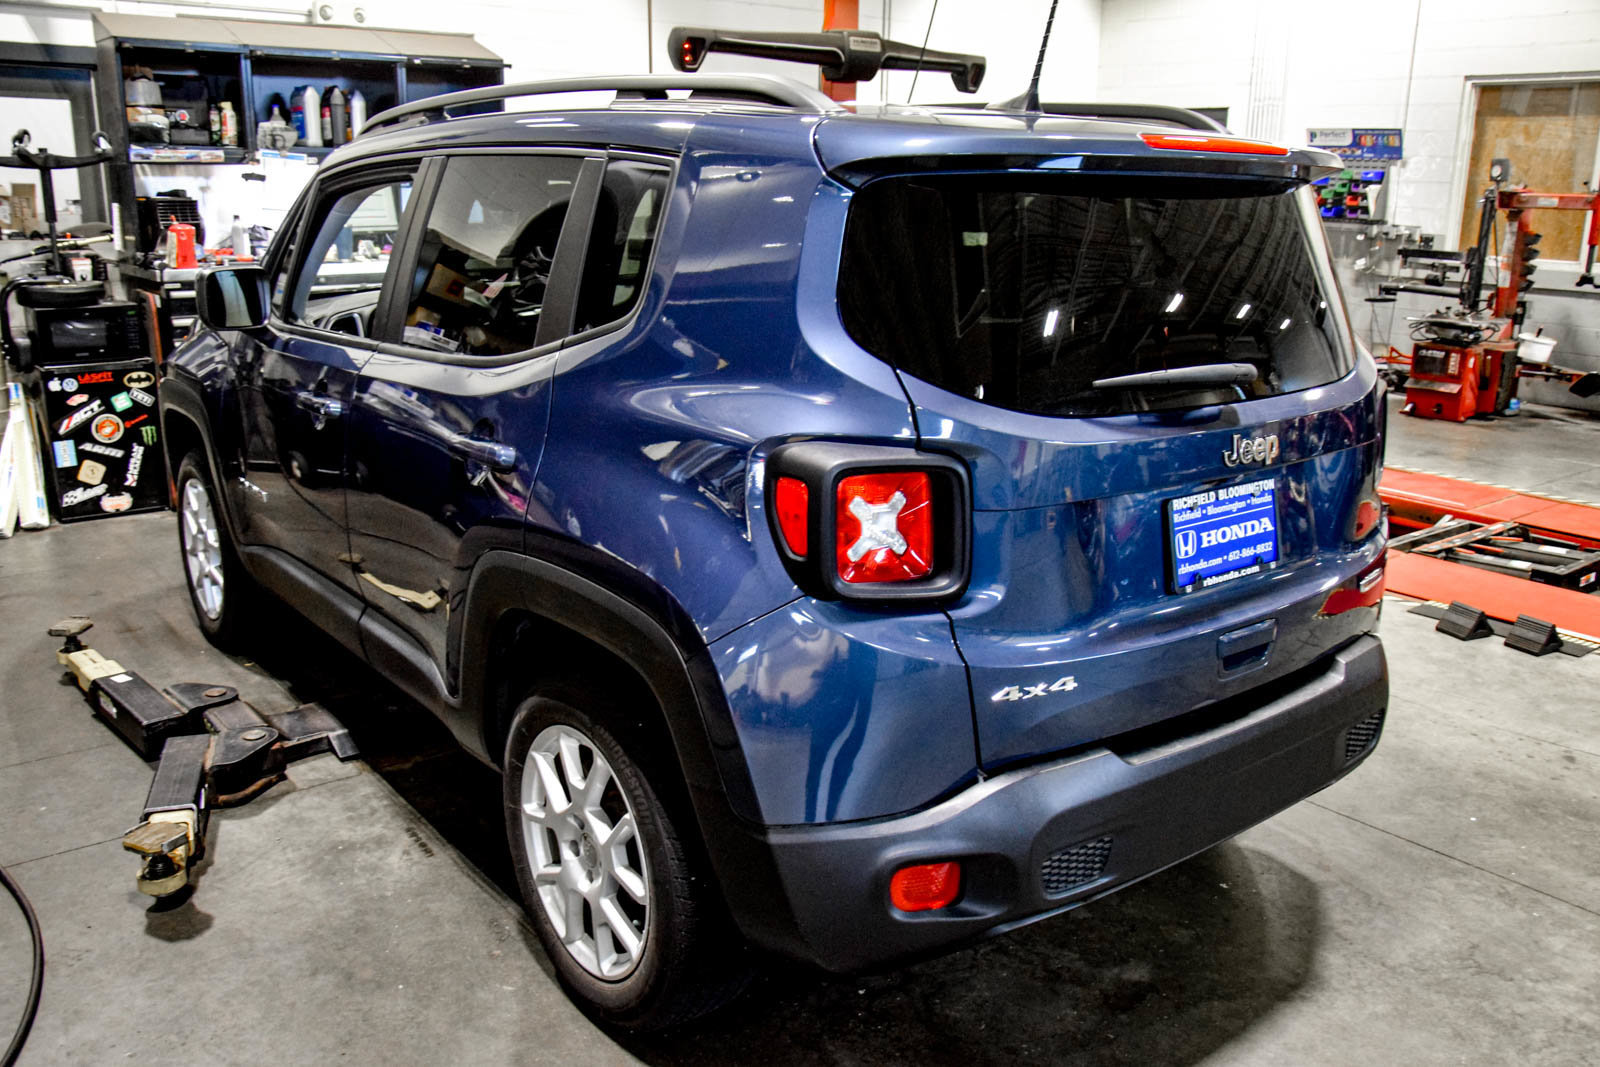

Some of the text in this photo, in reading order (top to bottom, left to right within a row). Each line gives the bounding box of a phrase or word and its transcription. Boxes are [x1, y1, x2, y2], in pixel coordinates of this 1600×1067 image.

[1222, 434, 1279, 467] Jeep
[1172, 478, 1275, 510] RICHFIELD BLOOMINGTON
[1200, 517, 1274, 548] HONDA
[1178, 557, 1223, 575] rbhonda.com
[1203, 565, 1260, 587] rbhonda.com
[991, 676, 1078, 701] 4x4
